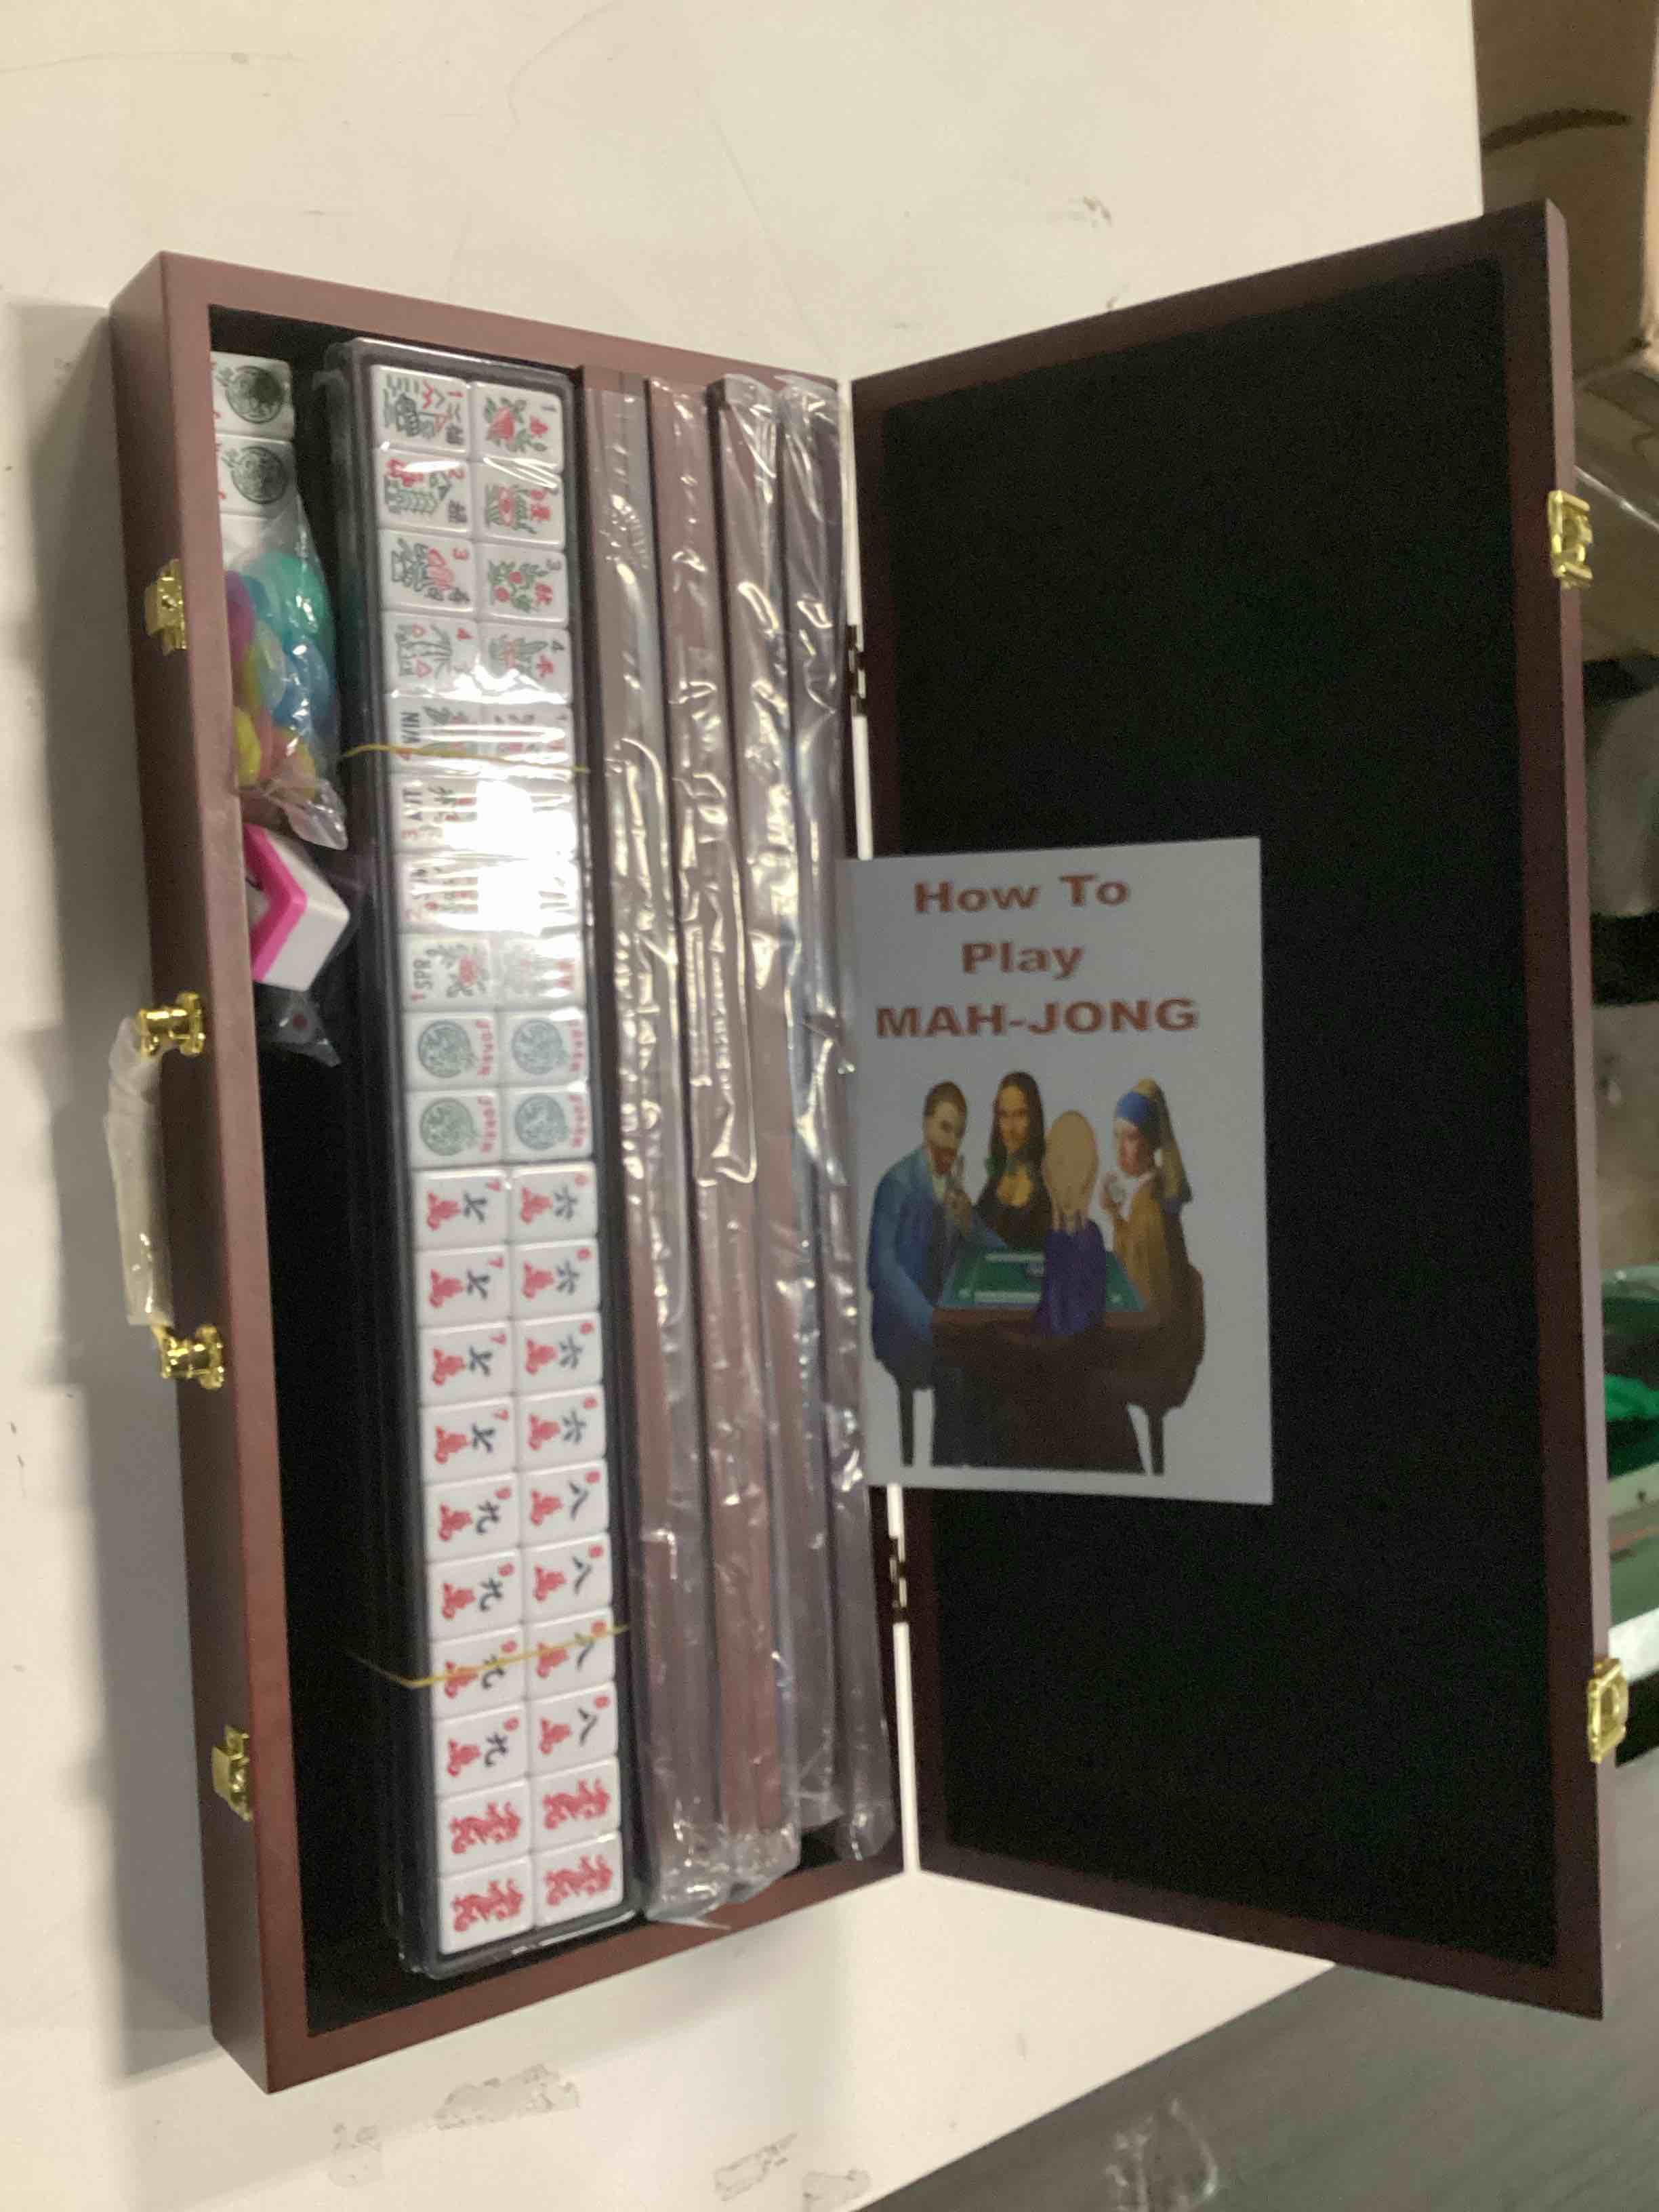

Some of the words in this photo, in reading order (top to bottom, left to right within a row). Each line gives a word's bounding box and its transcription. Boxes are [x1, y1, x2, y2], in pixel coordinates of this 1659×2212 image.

[914, 881, 1040, 914] How
[1059, 874, 1130, 907] To
[413, 958, 434, 990] SPR
[961, 941, 1084, 981] Play
[876, 997, 1198, 1038] MAH-JONG
